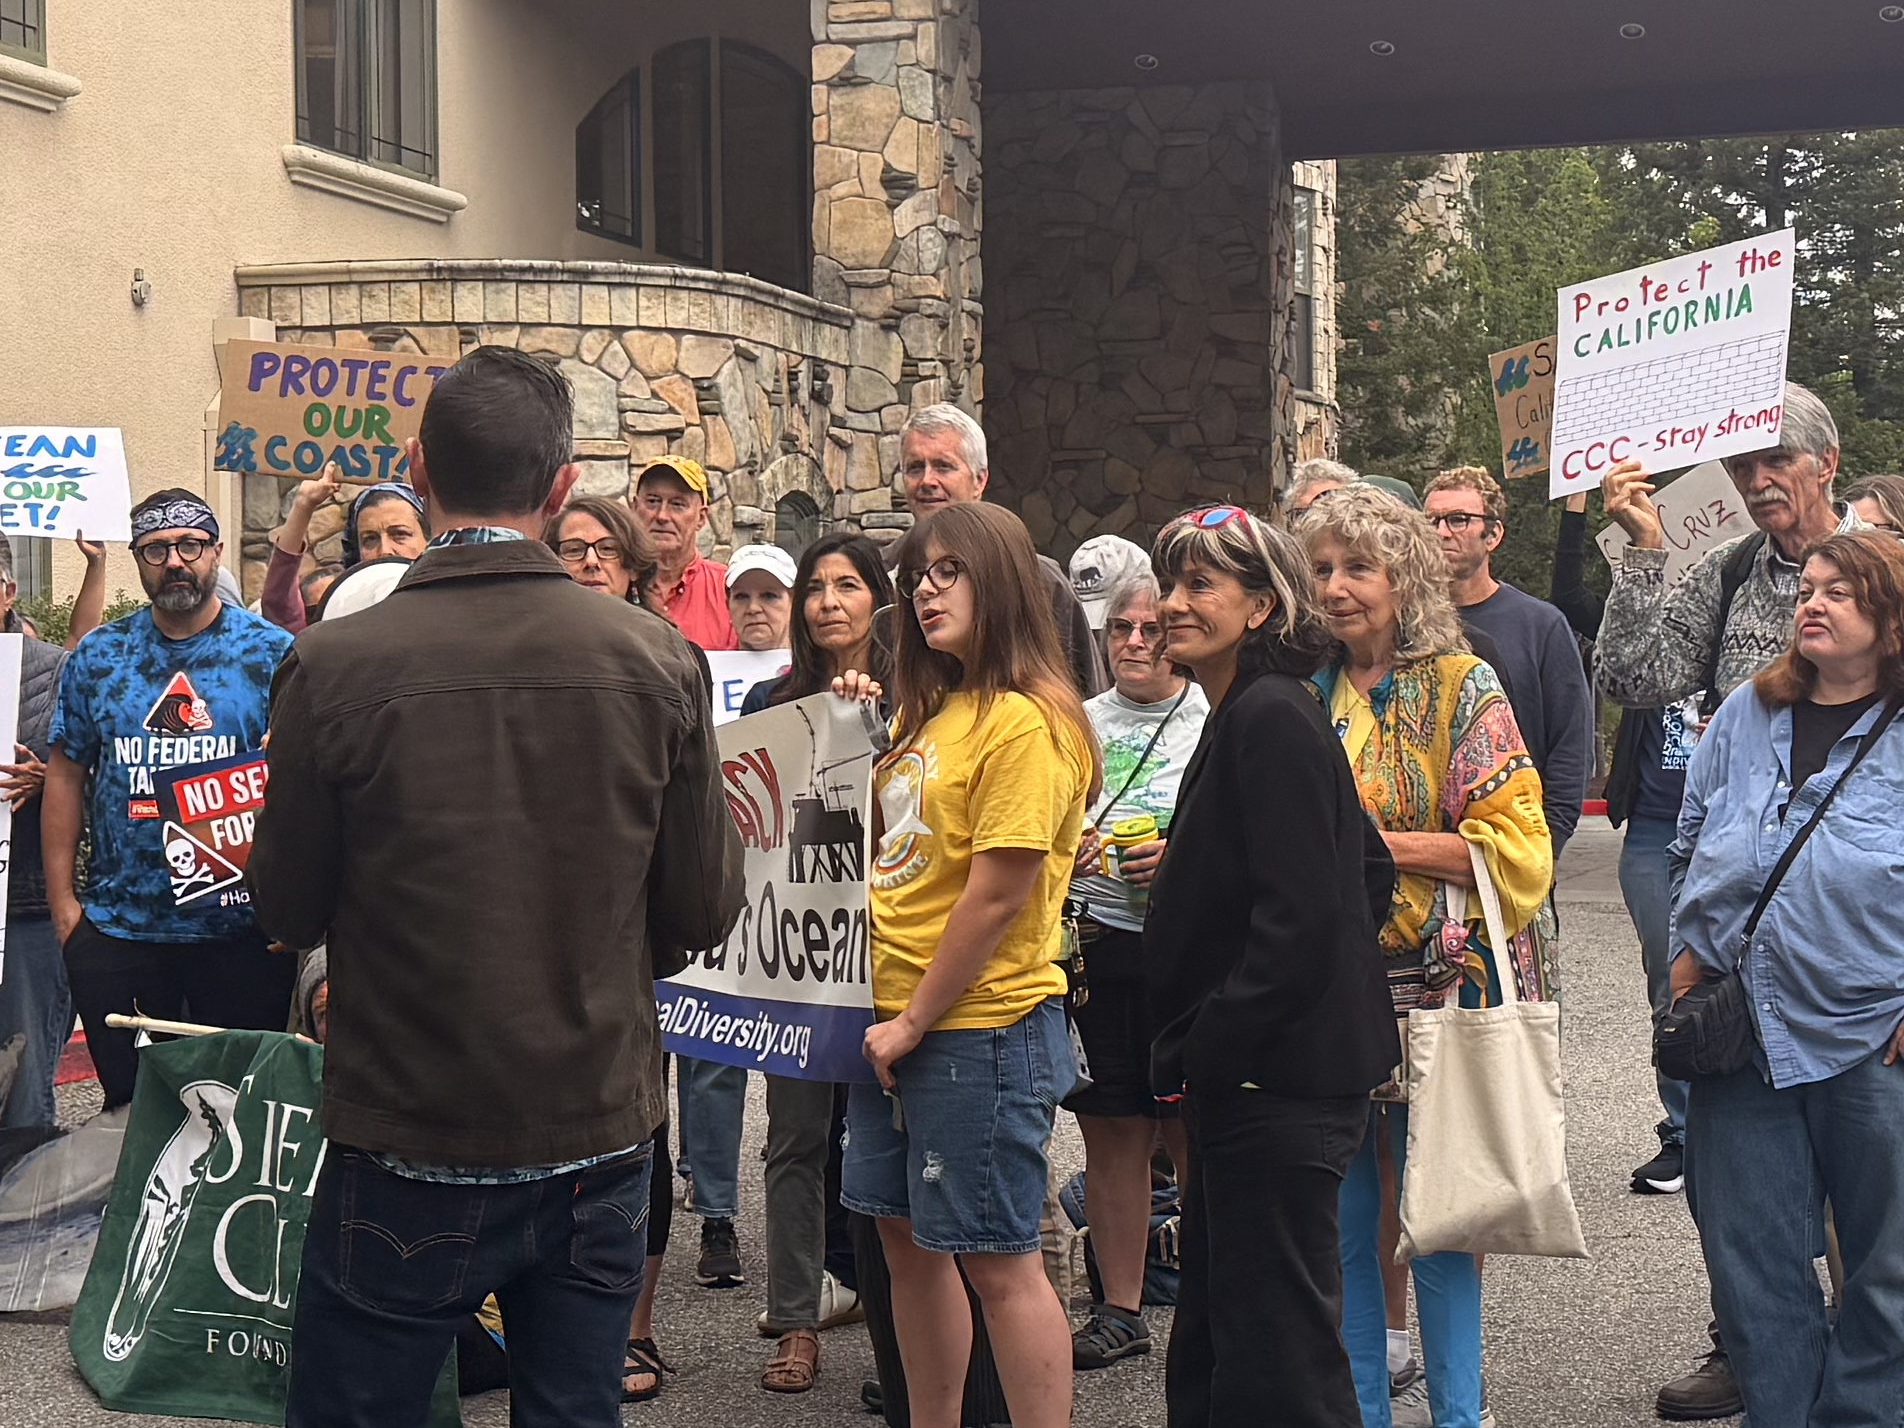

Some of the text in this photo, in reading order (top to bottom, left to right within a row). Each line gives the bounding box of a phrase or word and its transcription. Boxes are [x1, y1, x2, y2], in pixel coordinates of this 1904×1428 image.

[1573, 247, 1782, 323] Protect the
[1573, 283, 1753, 358] CALIFORNIA
[303, 401, 396, 446] OUR
[1713, 403, 1782, 439] strong
[264, 435, 409, 483] COAST!
[3, 480, 89, 502] OUR
[114, 736, 143, 764] NO
[182, 764, 269, 817] NO SE
[756, 880, 868, 985] Ocean
[654, 995, 812, 1070] alDiversity.org
[212, 1193, 292, 1310] CL
